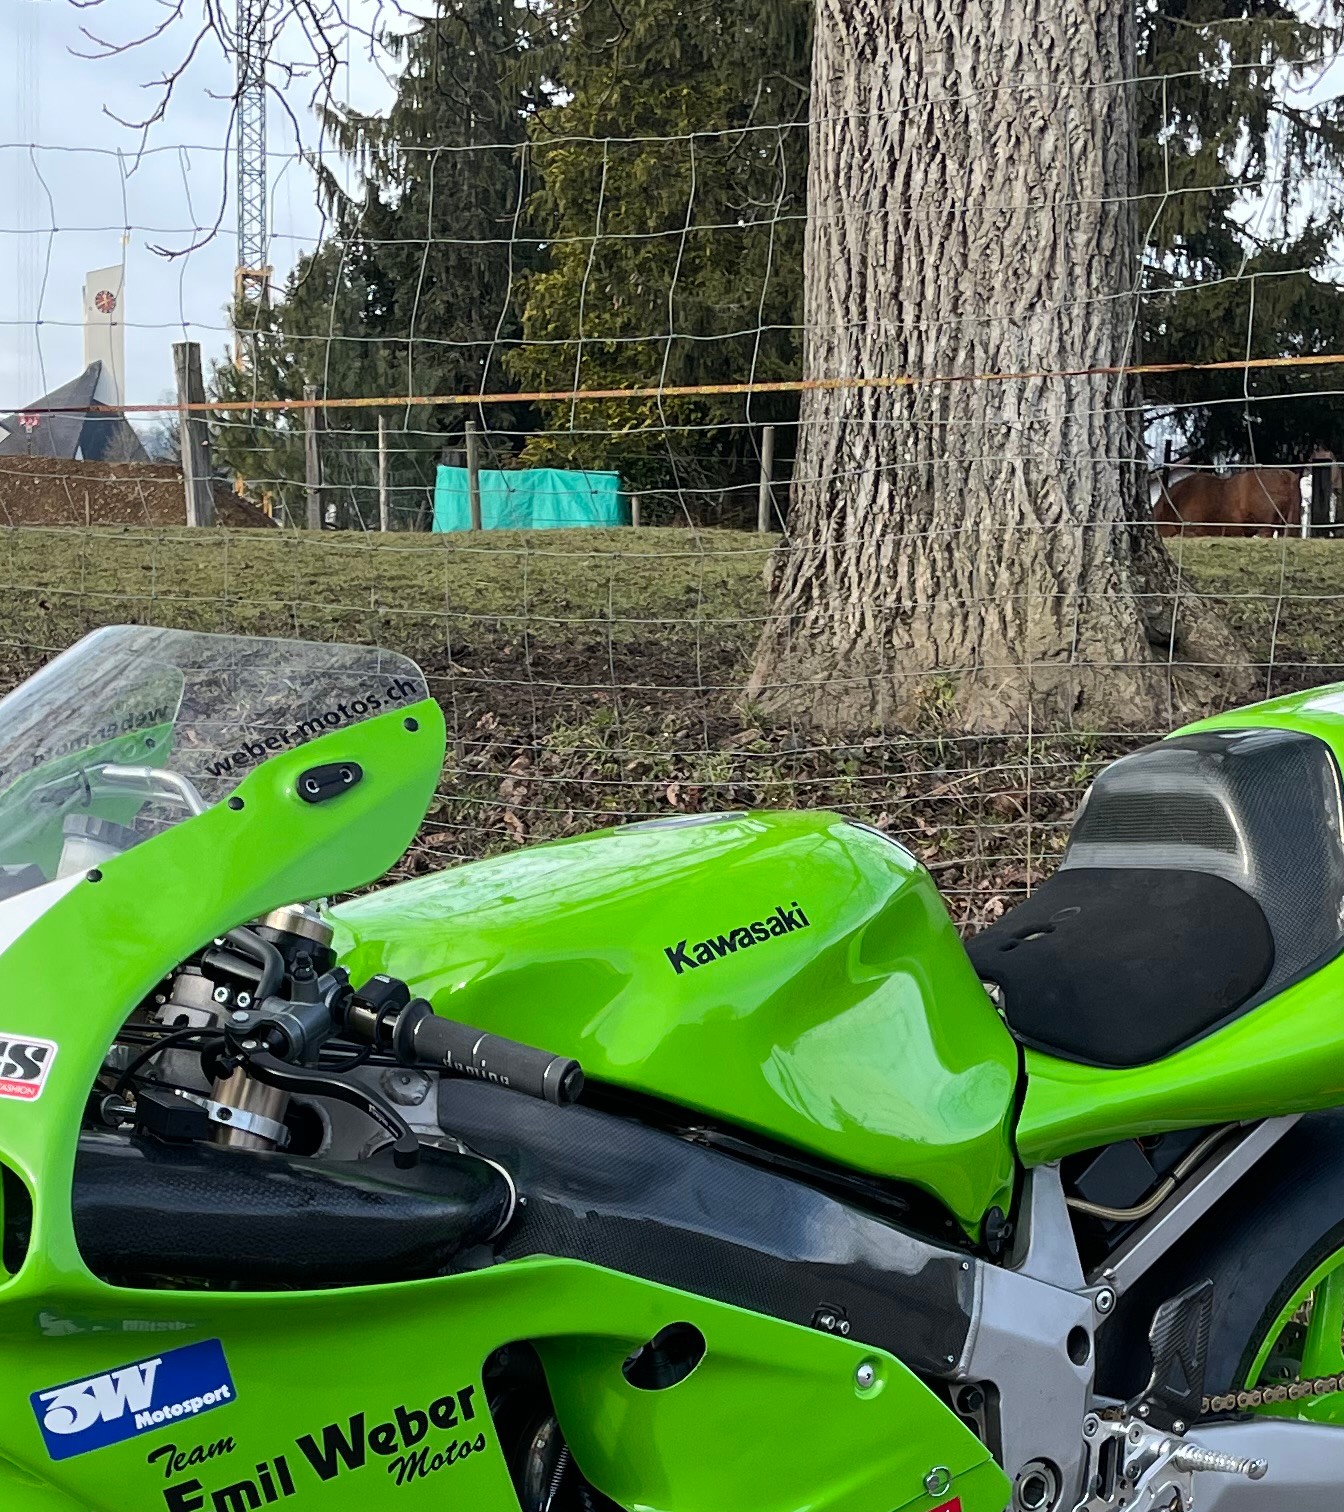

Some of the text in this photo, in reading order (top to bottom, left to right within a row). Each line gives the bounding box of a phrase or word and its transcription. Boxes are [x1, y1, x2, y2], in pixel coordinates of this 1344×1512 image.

[205, 678, 417, 778] weber-motos.ch
[663, 901, 811, 975] Kawasaki
[134, 1384, 232, 1430] Motosport
[295, 1384, 477, 1484] Weber
[146, 1435, 237, 1479] Team
[387, 1430, 487, 1487] Motos
